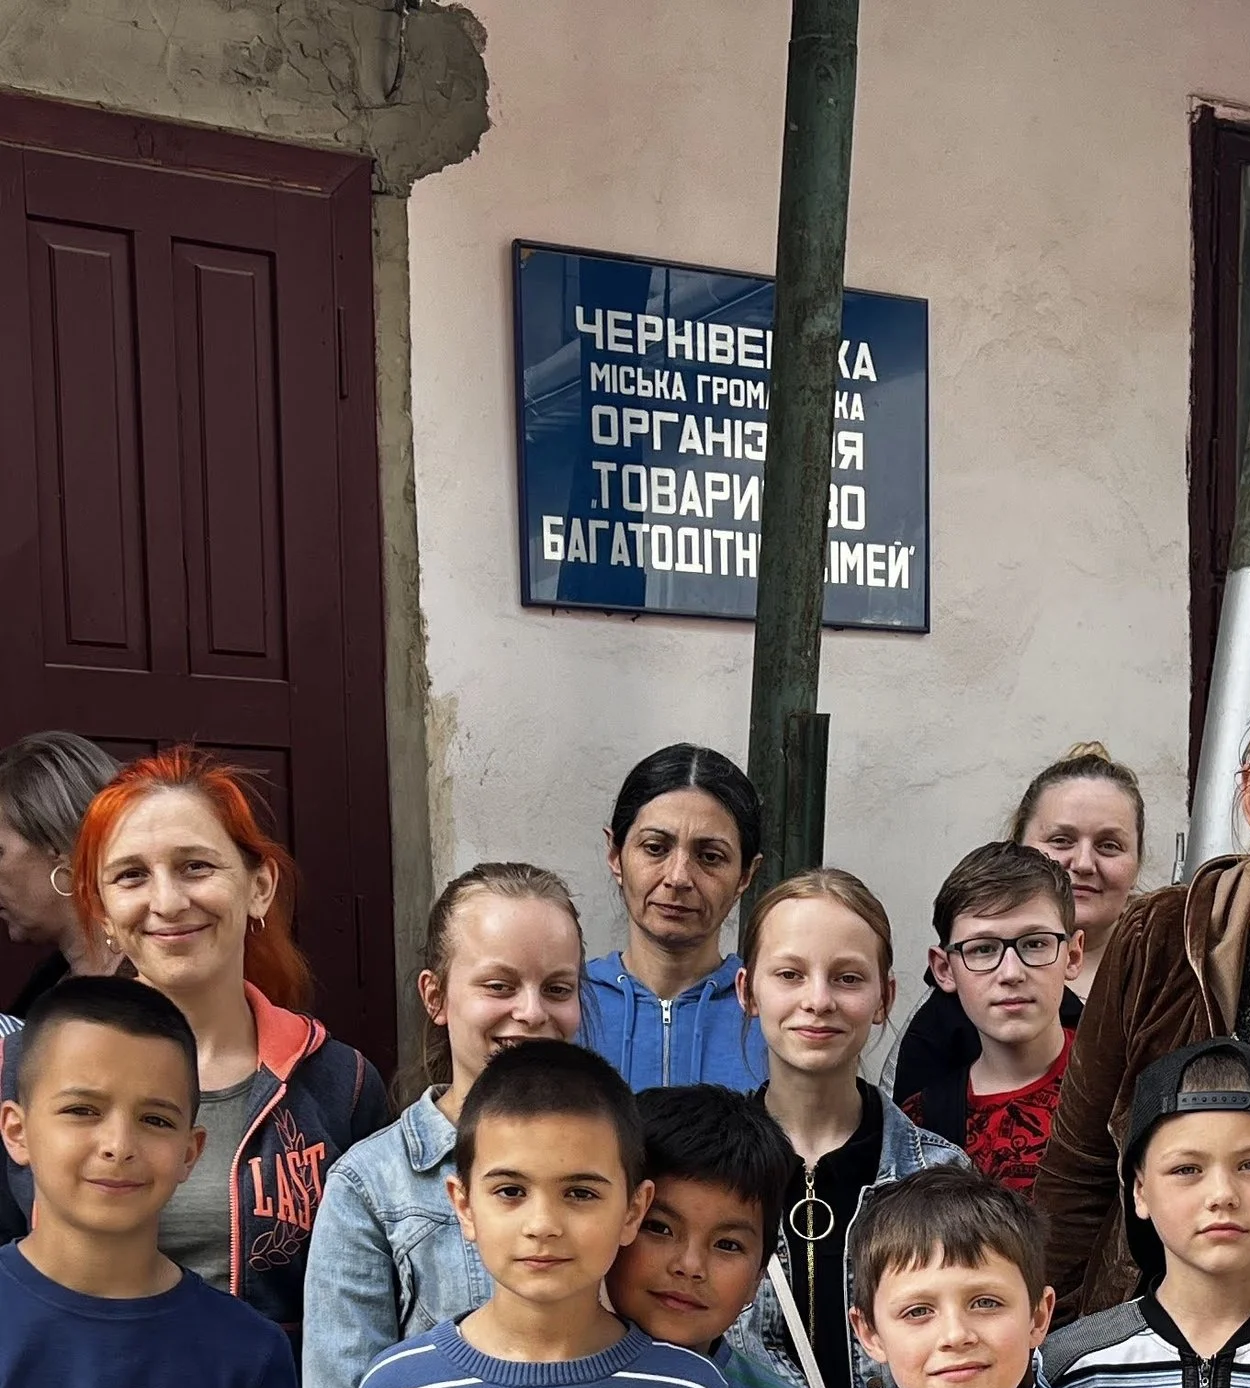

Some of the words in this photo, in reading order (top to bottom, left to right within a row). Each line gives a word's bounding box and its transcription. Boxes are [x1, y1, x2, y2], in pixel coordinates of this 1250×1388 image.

[575, 305, 877, 381] ЧЕРНІВЕКА
[590, 362, 687, 401] МІСЬКА
[697, 375, 865, 421] ГРОМКА
[591, 405, 864, 471] ОРГАНІЗЯ
[542, 515, 762, 578] БАГАТОДІТН
[248, 1142, 325, 1231] LAST
